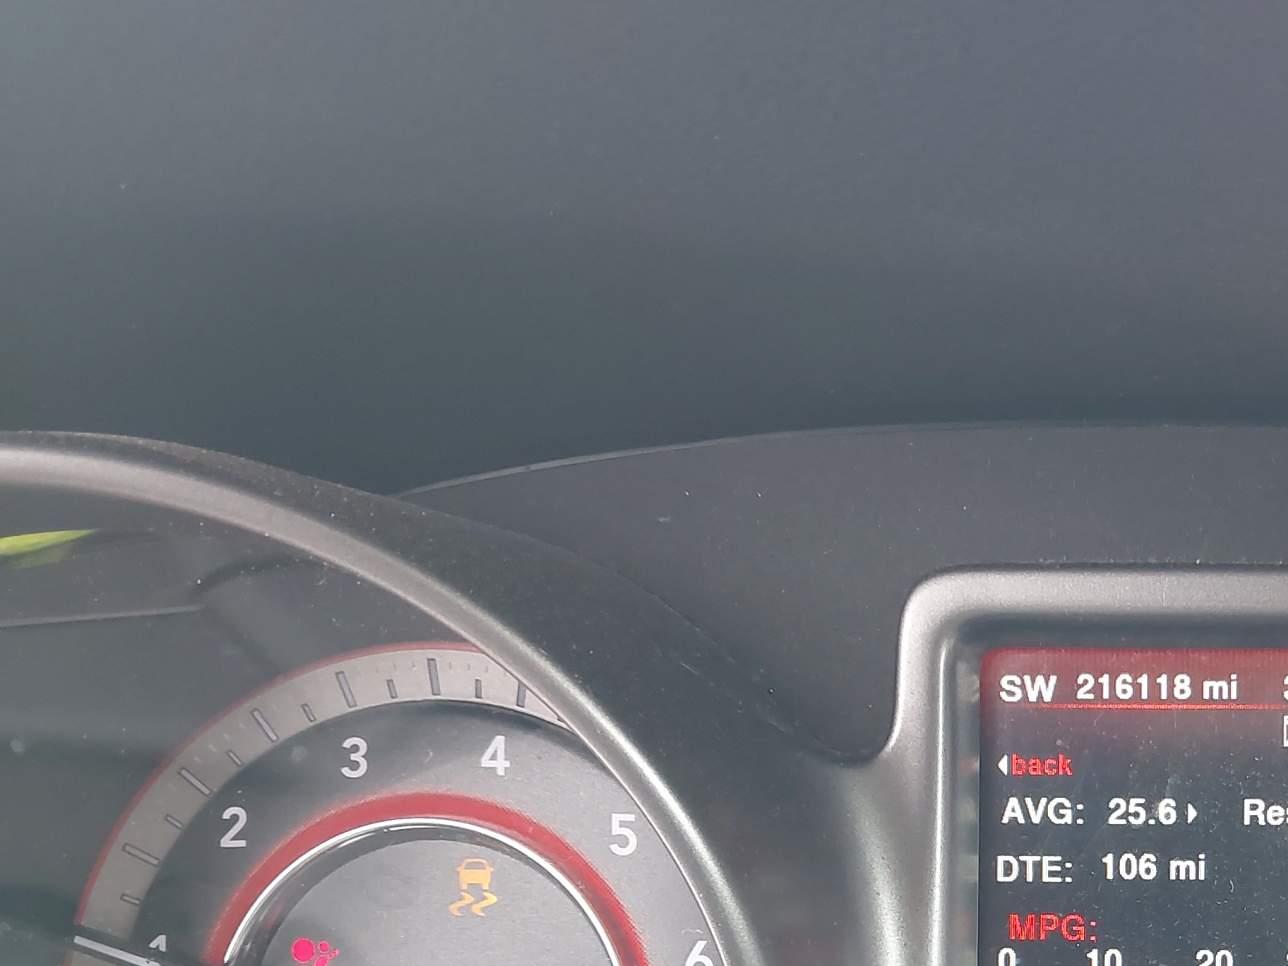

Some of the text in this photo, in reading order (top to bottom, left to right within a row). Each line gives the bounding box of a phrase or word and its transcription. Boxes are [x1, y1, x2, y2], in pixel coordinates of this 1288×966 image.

[999, 675, 1056, 702] SW
[1076, 675, 1191, 700] 216118
[1203, 674, 1238, 700] mi
[341, 737, 368, 778] 3
[480, 736, 511, 776] 4
[1011, 754, 1073, 776] back
[1001, 798, 1177, 824] AVG: 25.6
[220, 807, 247, 848] 2
[610, 815, 637, 856] 5
[997, 854, 1206, 882] DTE: 106 mi
[1008, 914, 1096, 942] MPG:
